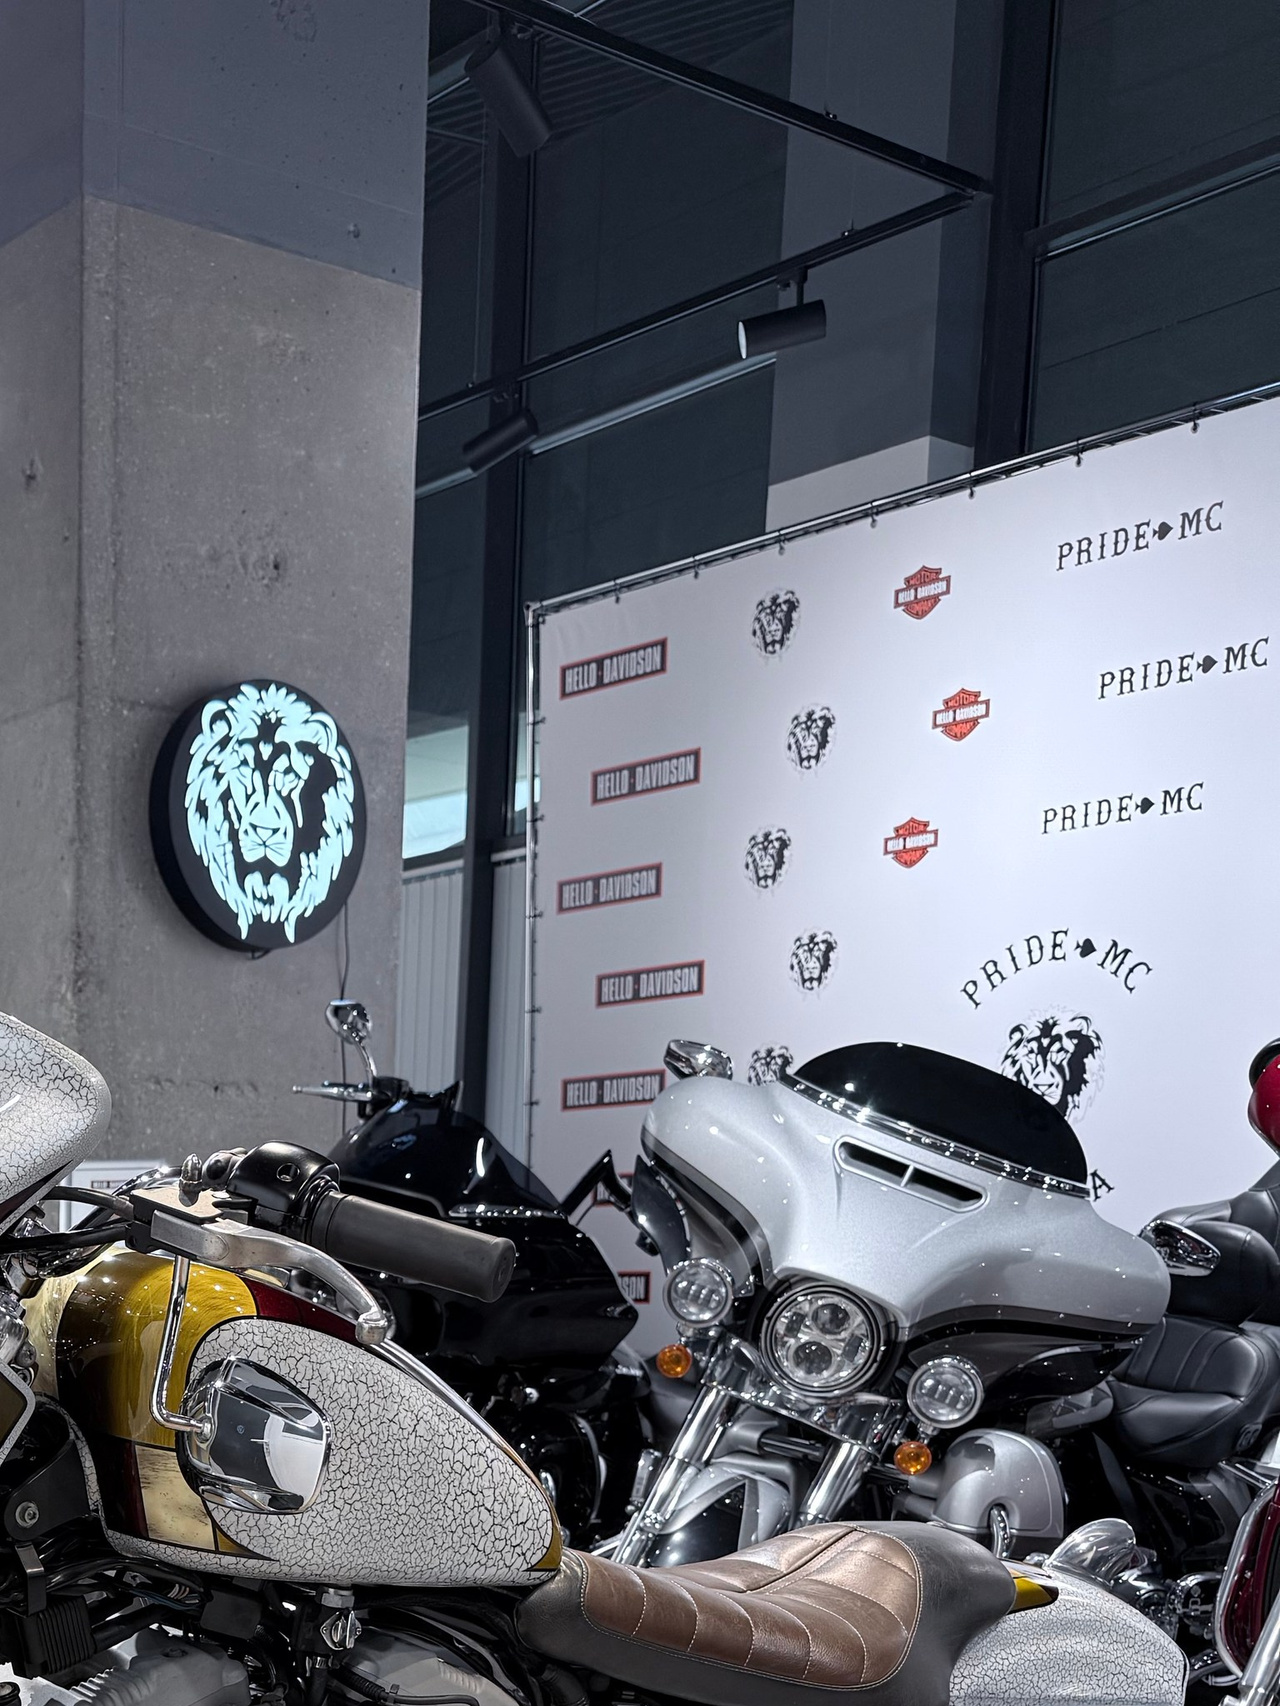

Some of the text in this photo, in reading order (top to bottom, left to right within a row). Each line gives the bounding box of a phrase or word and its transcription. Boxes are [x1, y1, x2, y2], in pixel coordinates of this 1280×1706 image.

[1056, 500, 1224, 572] PRIDE MC
[564, 644, 662, 694] HELLO DAVIDSON
[1098, 636, 1270, 700] PRIDE MC
[596, 753, 695, 800] HELLO DAVIDSON
[1042, 781, 1204, 835] PRIDE MC
[562, 869, 658, 909] HELLO DAVIDSON
[601, 965, 699, 1003] HELLO DAVIDSON
[960, 927, 1153, 1010] PRIDE MC
[566, 1075, 661, 1107] HELLO DAVIDSON
